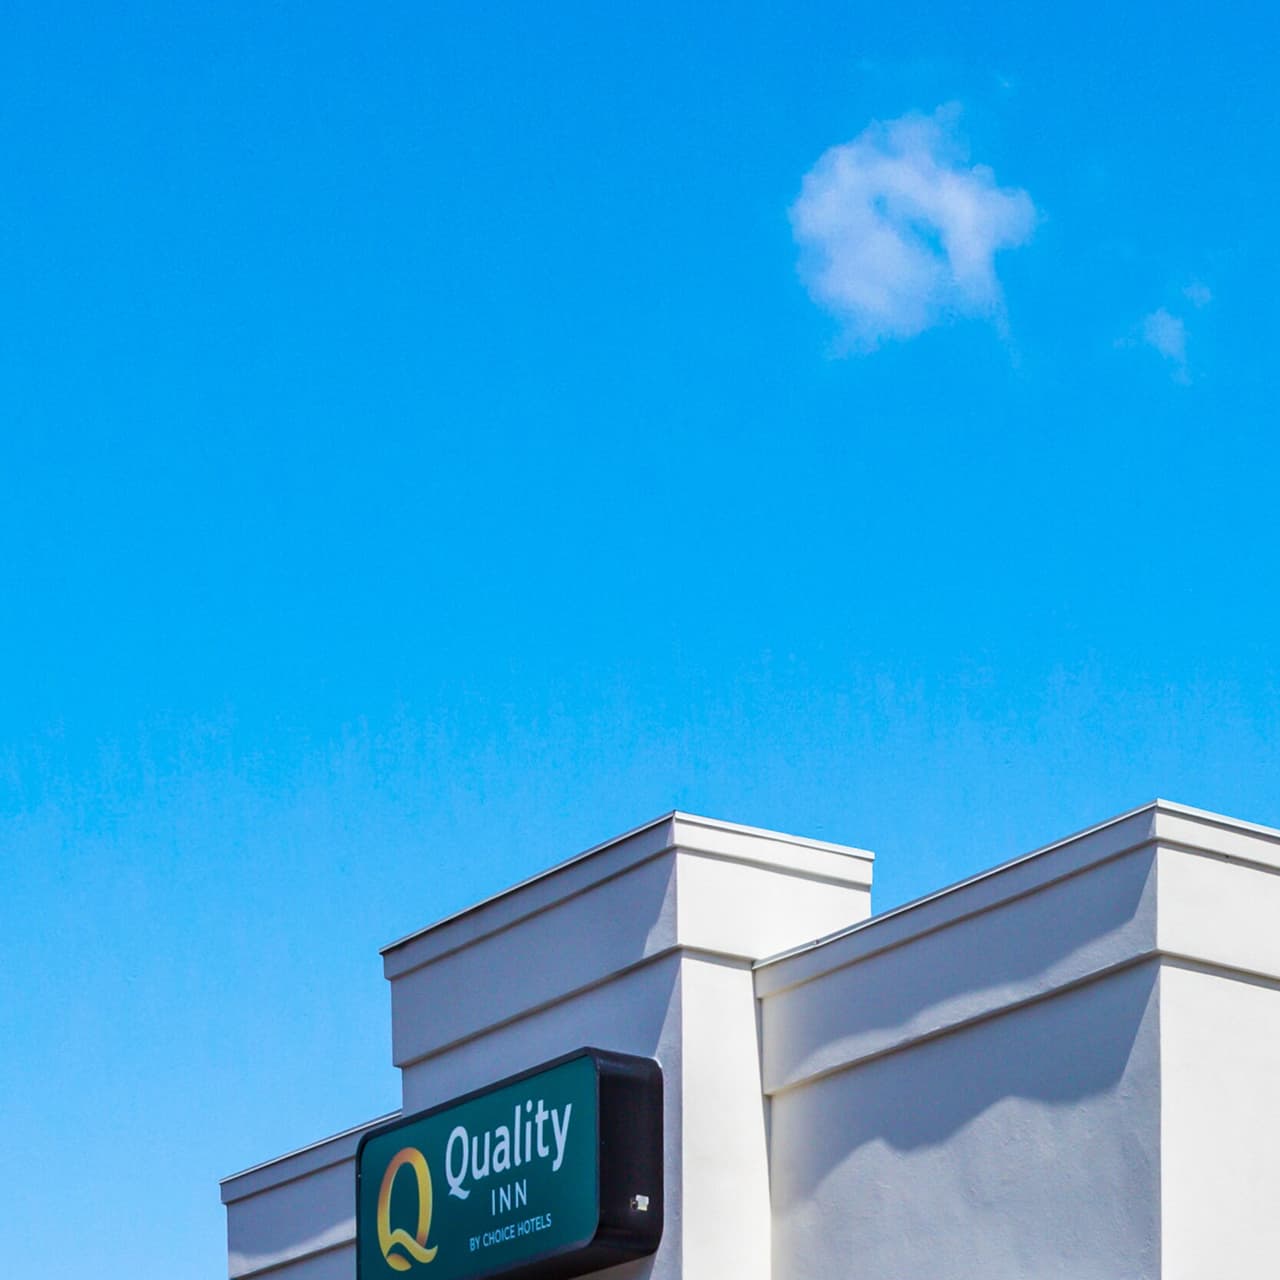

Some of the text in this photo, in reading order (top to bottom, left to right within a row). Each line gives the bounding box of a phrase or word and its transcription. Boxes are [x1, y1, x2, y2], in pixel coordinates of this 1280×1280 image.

[445, 1098, 572, 1200] Quality
[491, 1179, 528, 1216] INN
[469, 1212, 552, 1253] BY CHOICE HOTELS
